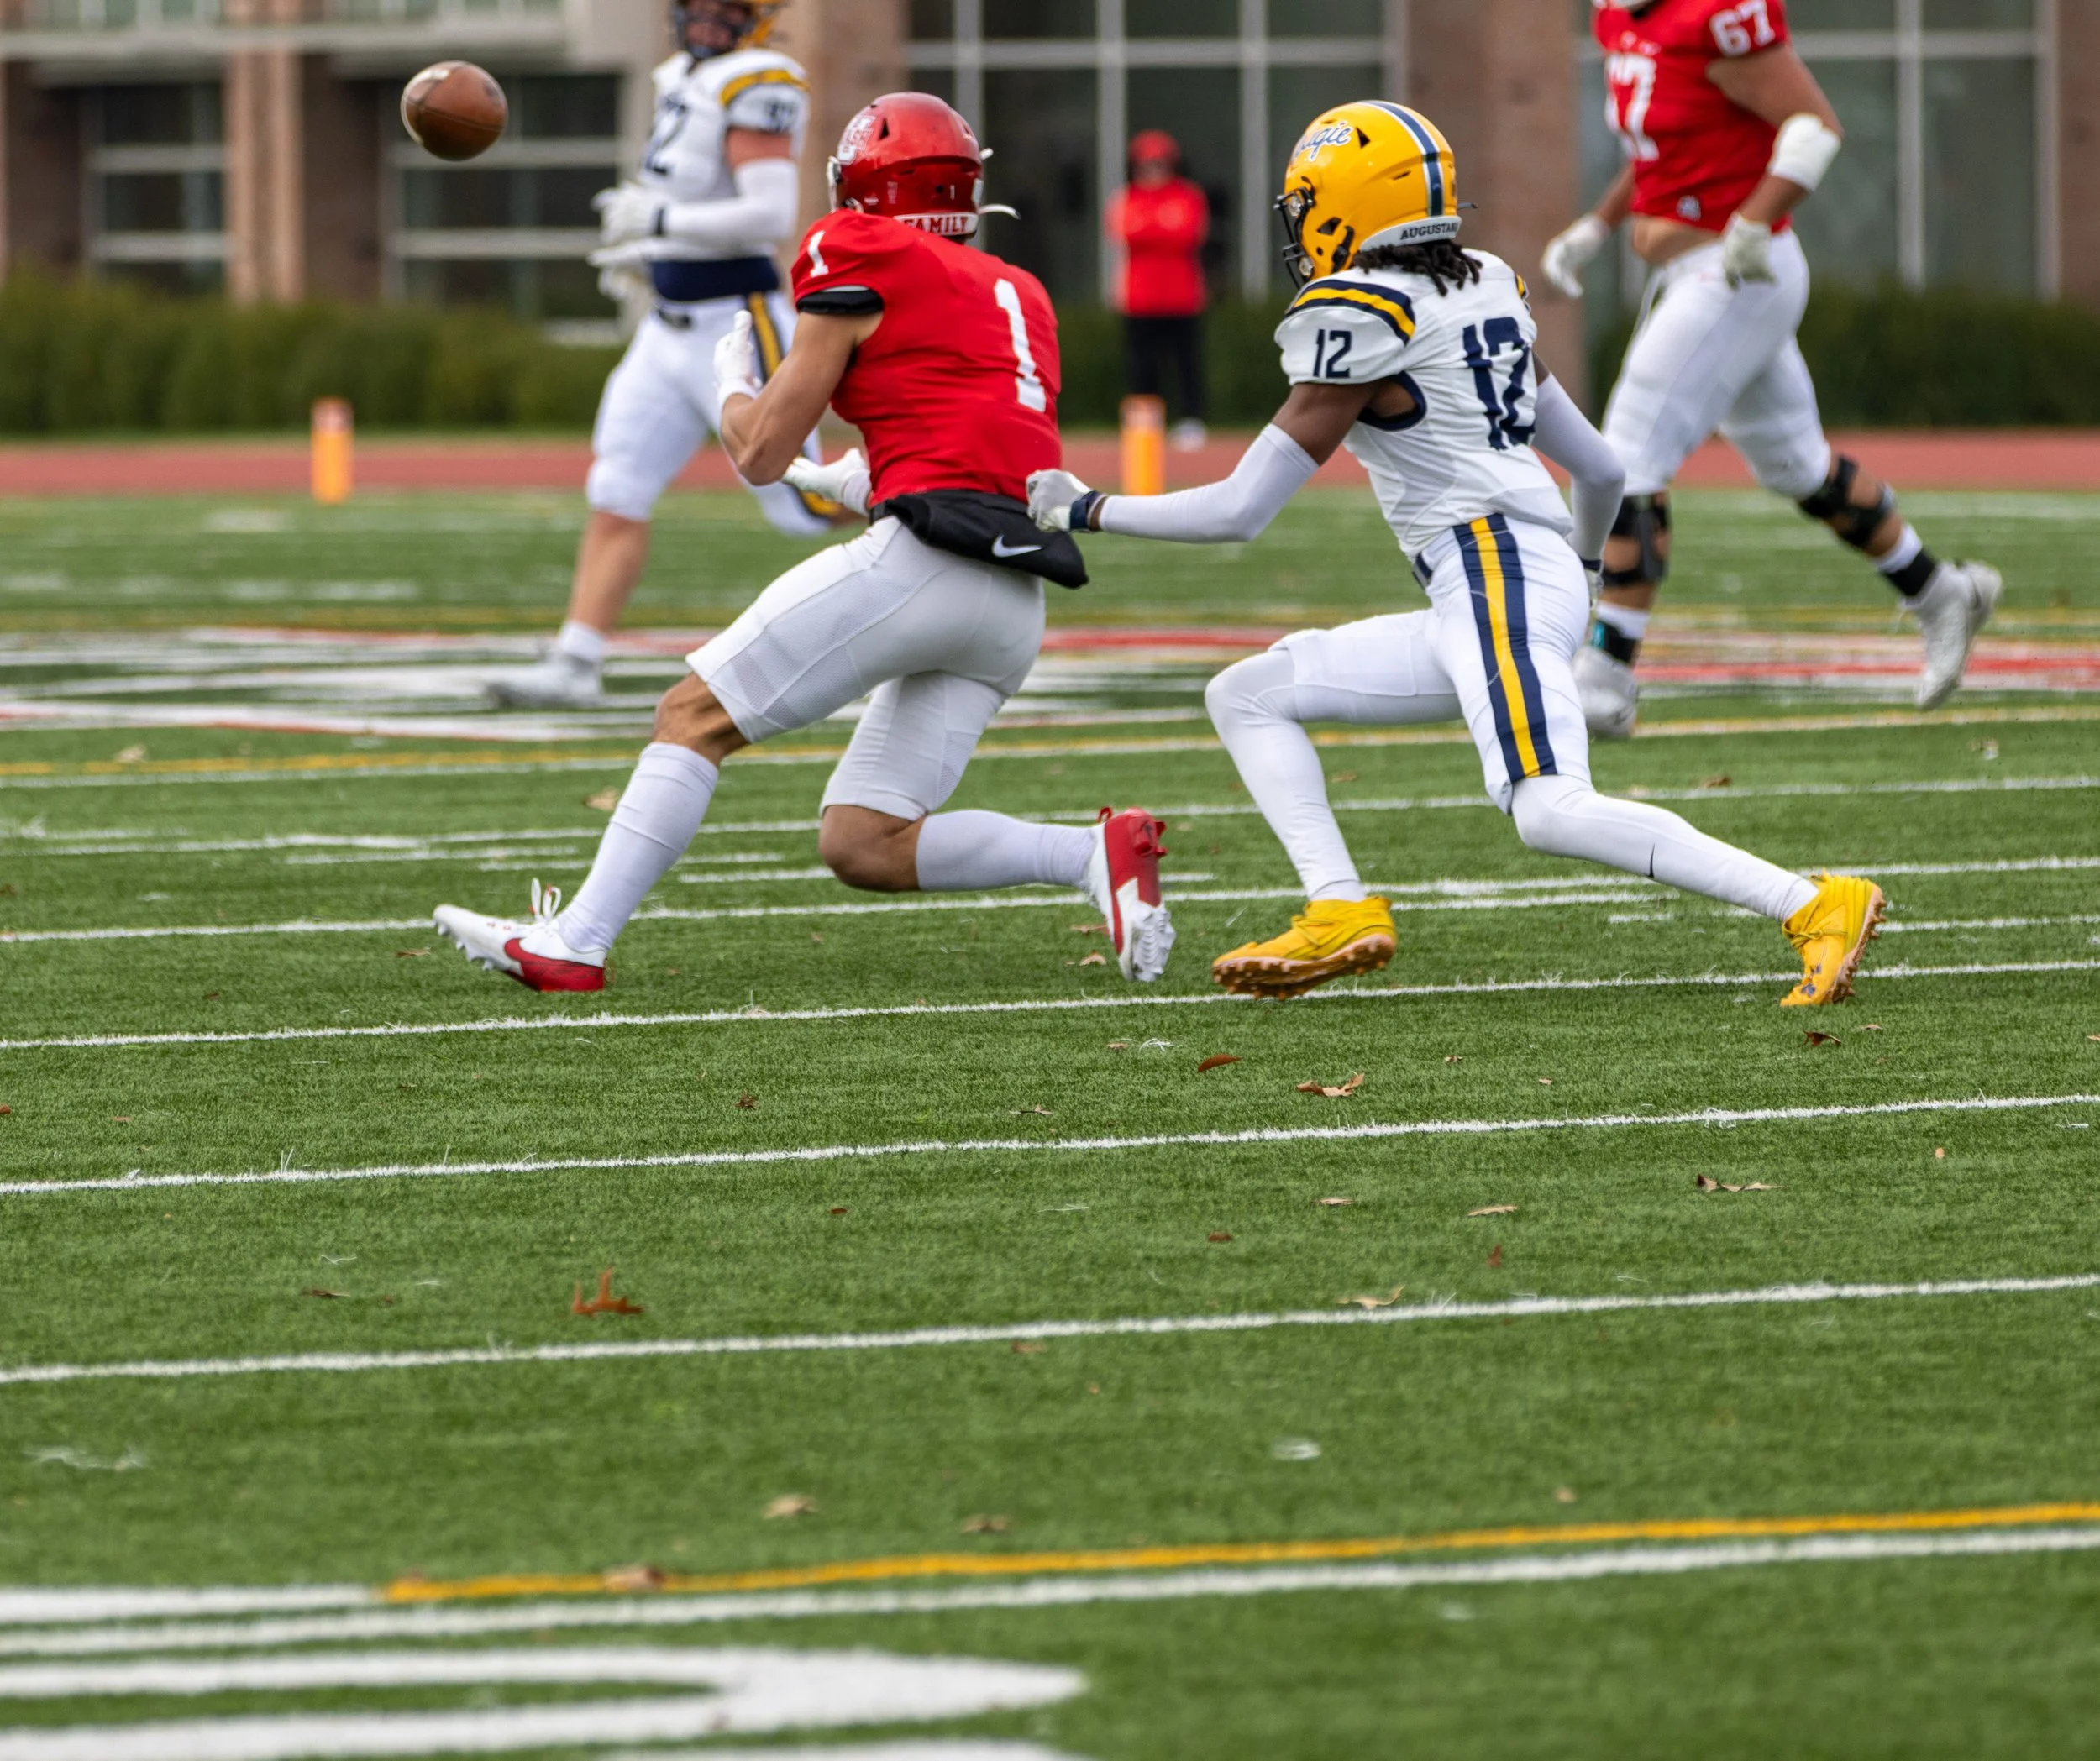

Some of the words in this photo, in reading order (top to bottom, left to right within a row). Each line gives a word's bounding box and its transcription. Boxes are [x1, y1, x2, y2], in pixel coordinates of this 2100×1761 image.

[1709, 0, 1776, 56] 67
[807, 229, 830, 278] 1
[994, 278, 1047, 413] 1
[1312, 328, 1352, 378] 12
[1462, 317, 1536, 451] 12
